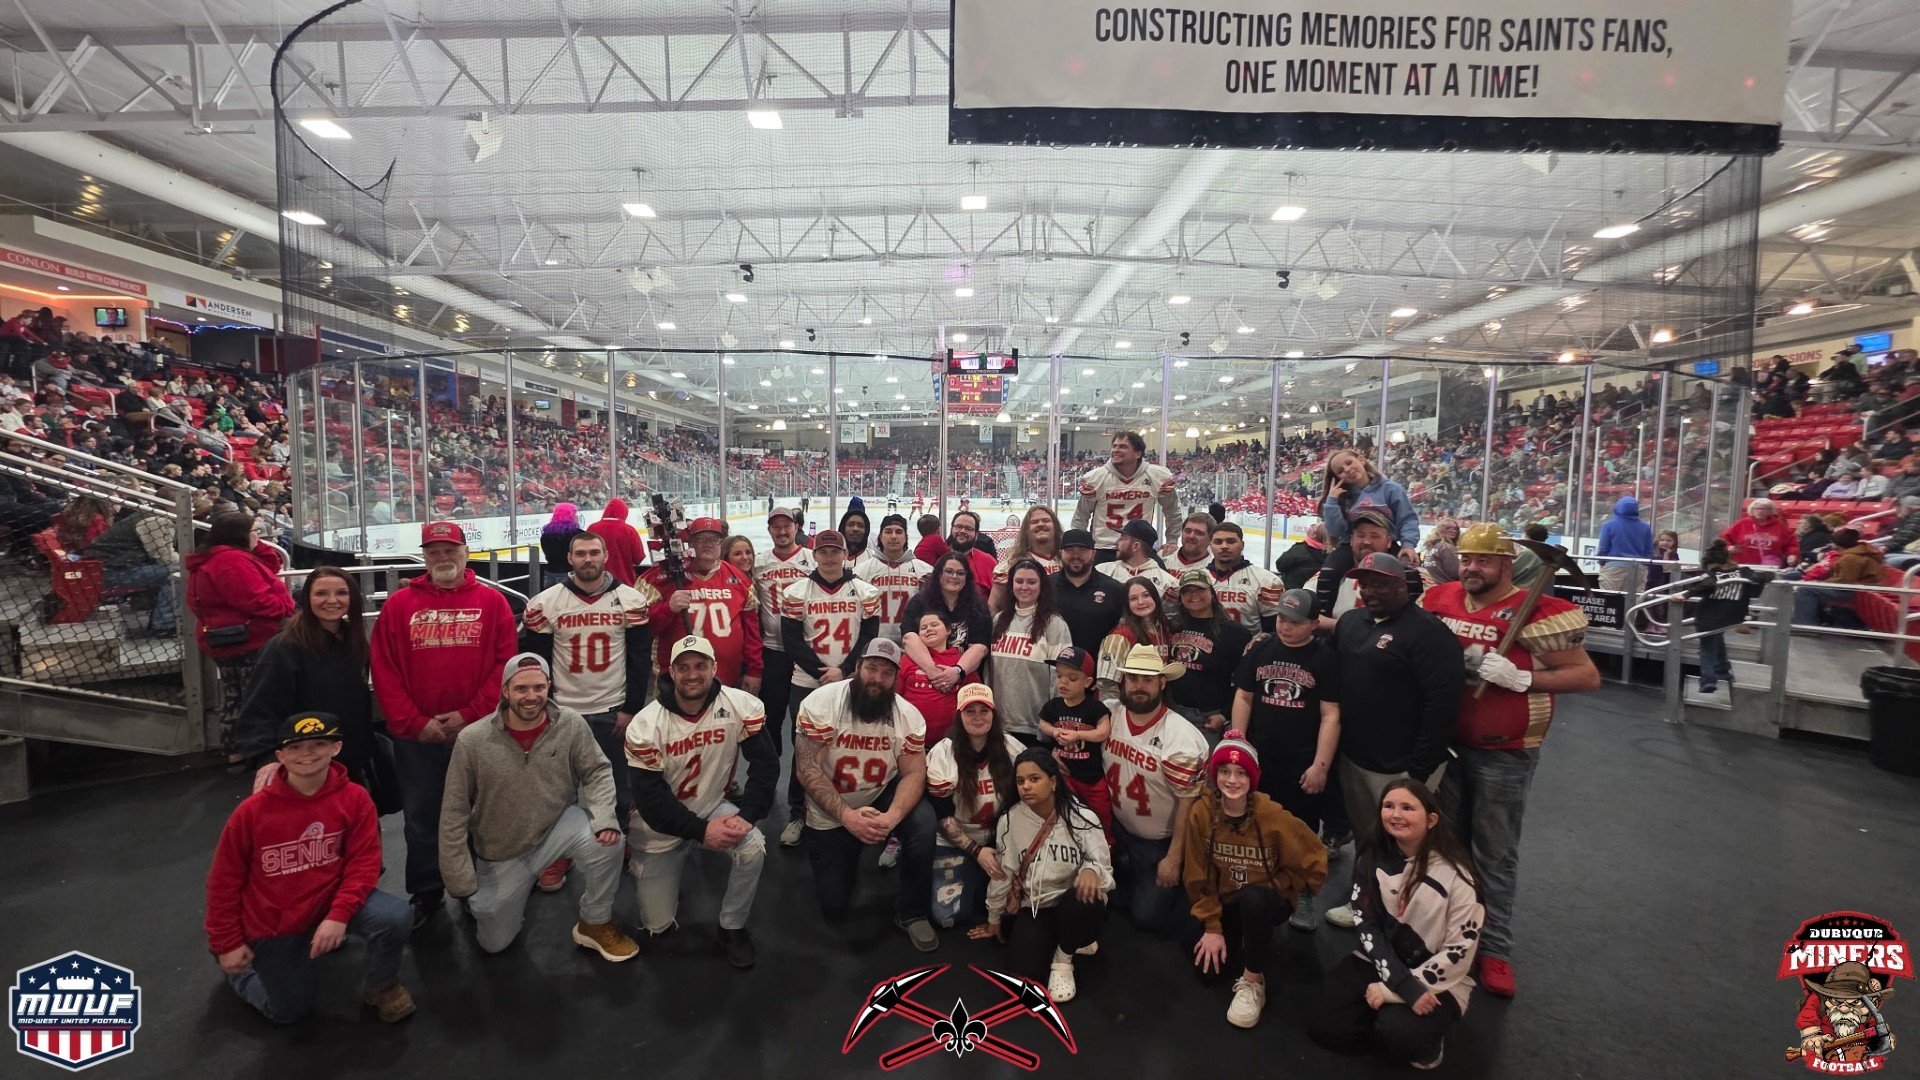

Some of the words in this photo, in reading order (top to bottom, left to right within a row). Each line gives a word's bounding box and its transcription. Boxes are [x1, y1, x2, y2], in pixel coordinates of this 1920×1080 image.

[1095, 7, 1292, 48] CONSTRUCTING
[1300, 11, 1437, 50] MEMORIES
[1444, 16, 1492, 51] FOR
[1499, 17, 1595, 53] SAINTS
[1602, 18, 1673, 58] FANS,
[1225, 59, 1277, 94] ONE
[1285, 58, 1398, 96] MOMENT
[1403, 62, 1437, 97] AT
[1442, 63, 1460, 96] A
[1468, 64, 1540, 98] TIME!
[6, 252, 60, 273] CONLON
[64, 267, 86, 279] BUILD
[85, 272, 103, 283] WITH
[103, 276, 141, 292] CONFIDENCE
[207, 301, 252, 317] ANDERSEN
[1105, 489, 1151, 501] MINERS
[689, 588, 732, 600] INERS
[870, 575, 919, 587] MINERS
[808, 601, 857, 615] MINERS
[879, 590, 910, 624] 17
[1572, 595, 1605, 606] PLEASE!
[1606, 607, 1617, 616] IN
[410, 622, 483, 640] MINERS
[557, 612, 624, 629] MINERS
[688, 601, 732, 638] 70
[1594, 614, 1617, 624] AREA
[811, 618, 853, 655] 24
[568, 631, 612, 674] 10
[665, 727, 726, 757] MINERS
[835, 733, 891, 752] MINERS
[1104, 736, 1159, 773] MINERS
[676, 753, 703, 801] 2
[832, 754, 889, 795] 69
[1105, 761, 1153, 818] 44
